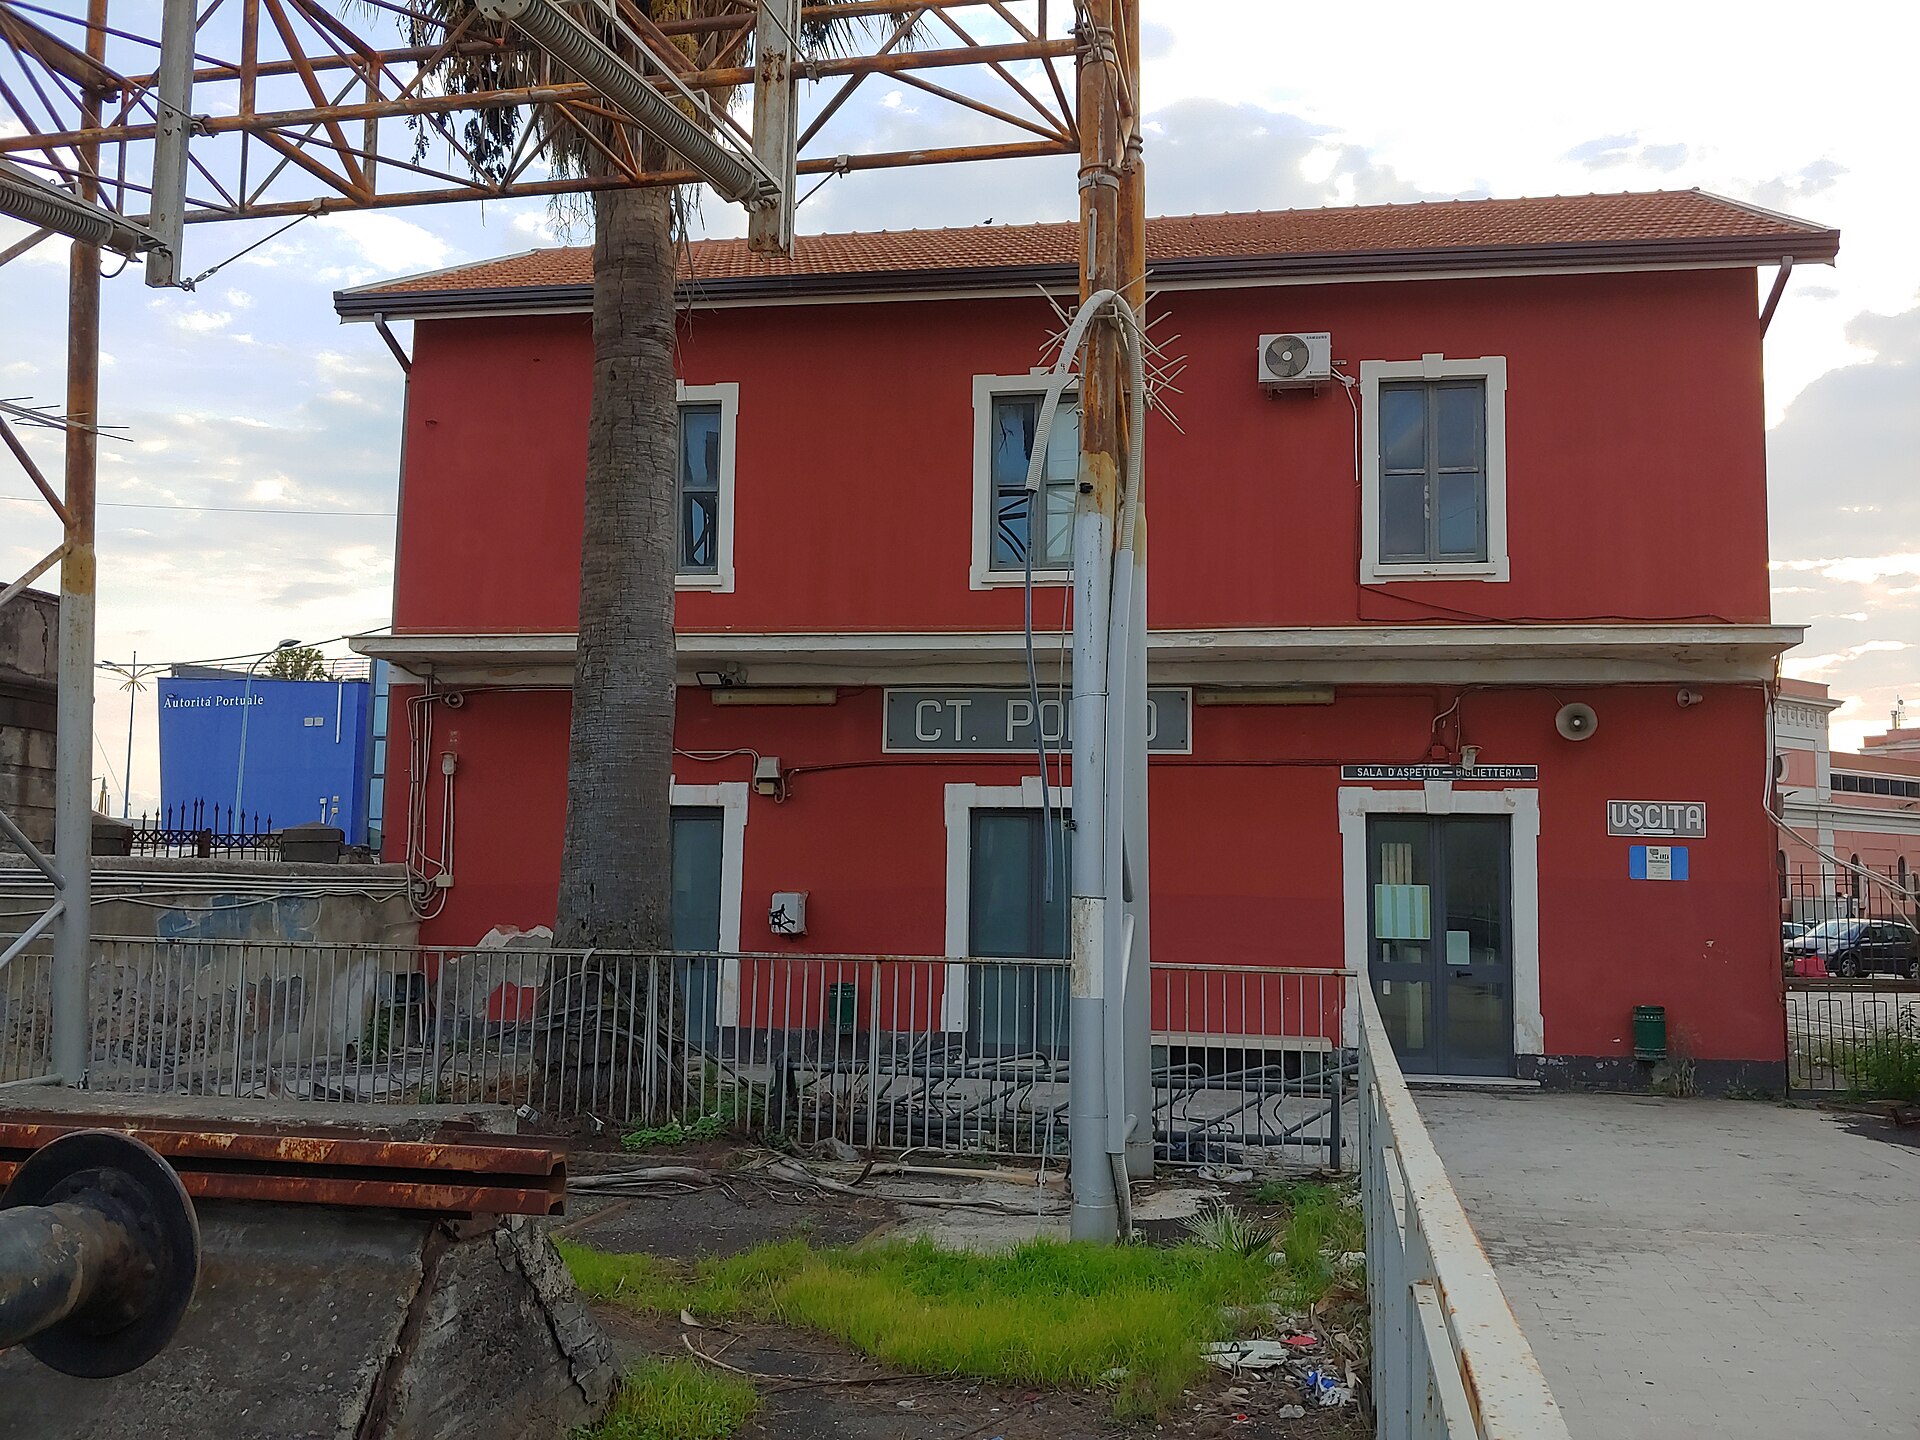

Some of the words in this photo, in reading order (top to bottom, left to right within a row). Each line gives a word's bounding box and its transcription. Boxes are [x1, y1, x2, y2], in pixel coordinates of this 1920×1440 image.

[215, 694, 264, 706] Portuale
[915, 699, 977, 741] CT.
[1357, 767, 1383, 777] SALA
[1388, 767, 1439, 777] D'ASPETTO
[1455, 768, 1522, 777] BIGLIETTERIA
[1611, 804, 1702, 829] USCITA
